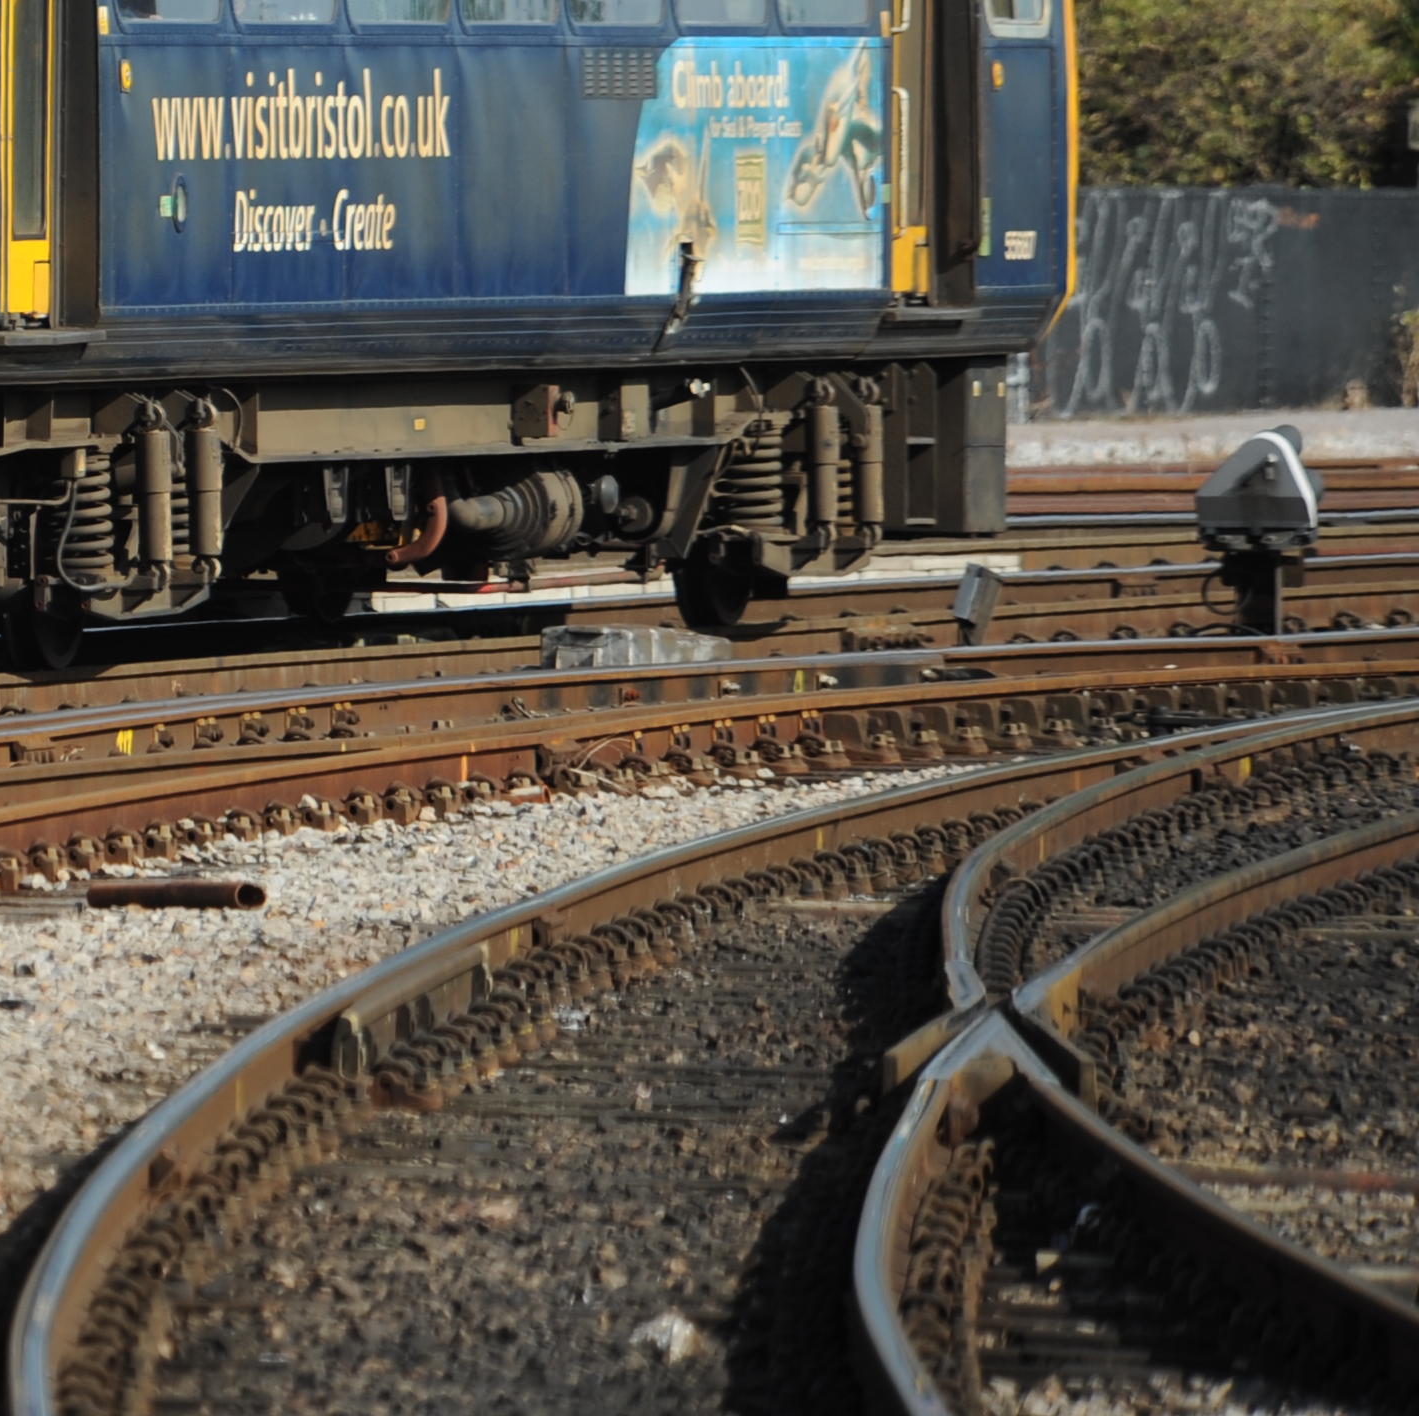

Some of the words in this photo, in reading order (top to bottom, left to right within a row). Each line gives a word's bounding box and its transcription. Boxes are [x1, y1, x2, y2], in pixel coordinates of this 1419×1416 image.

[151, 68, 451, 161] www.visitbristol.co.uk
[672, 59, 723, 110] Climb
[727, 59, 791, 109] aboard!
[233, 189, 316, 252] Discover
[332, 188, 396, 251] Create
